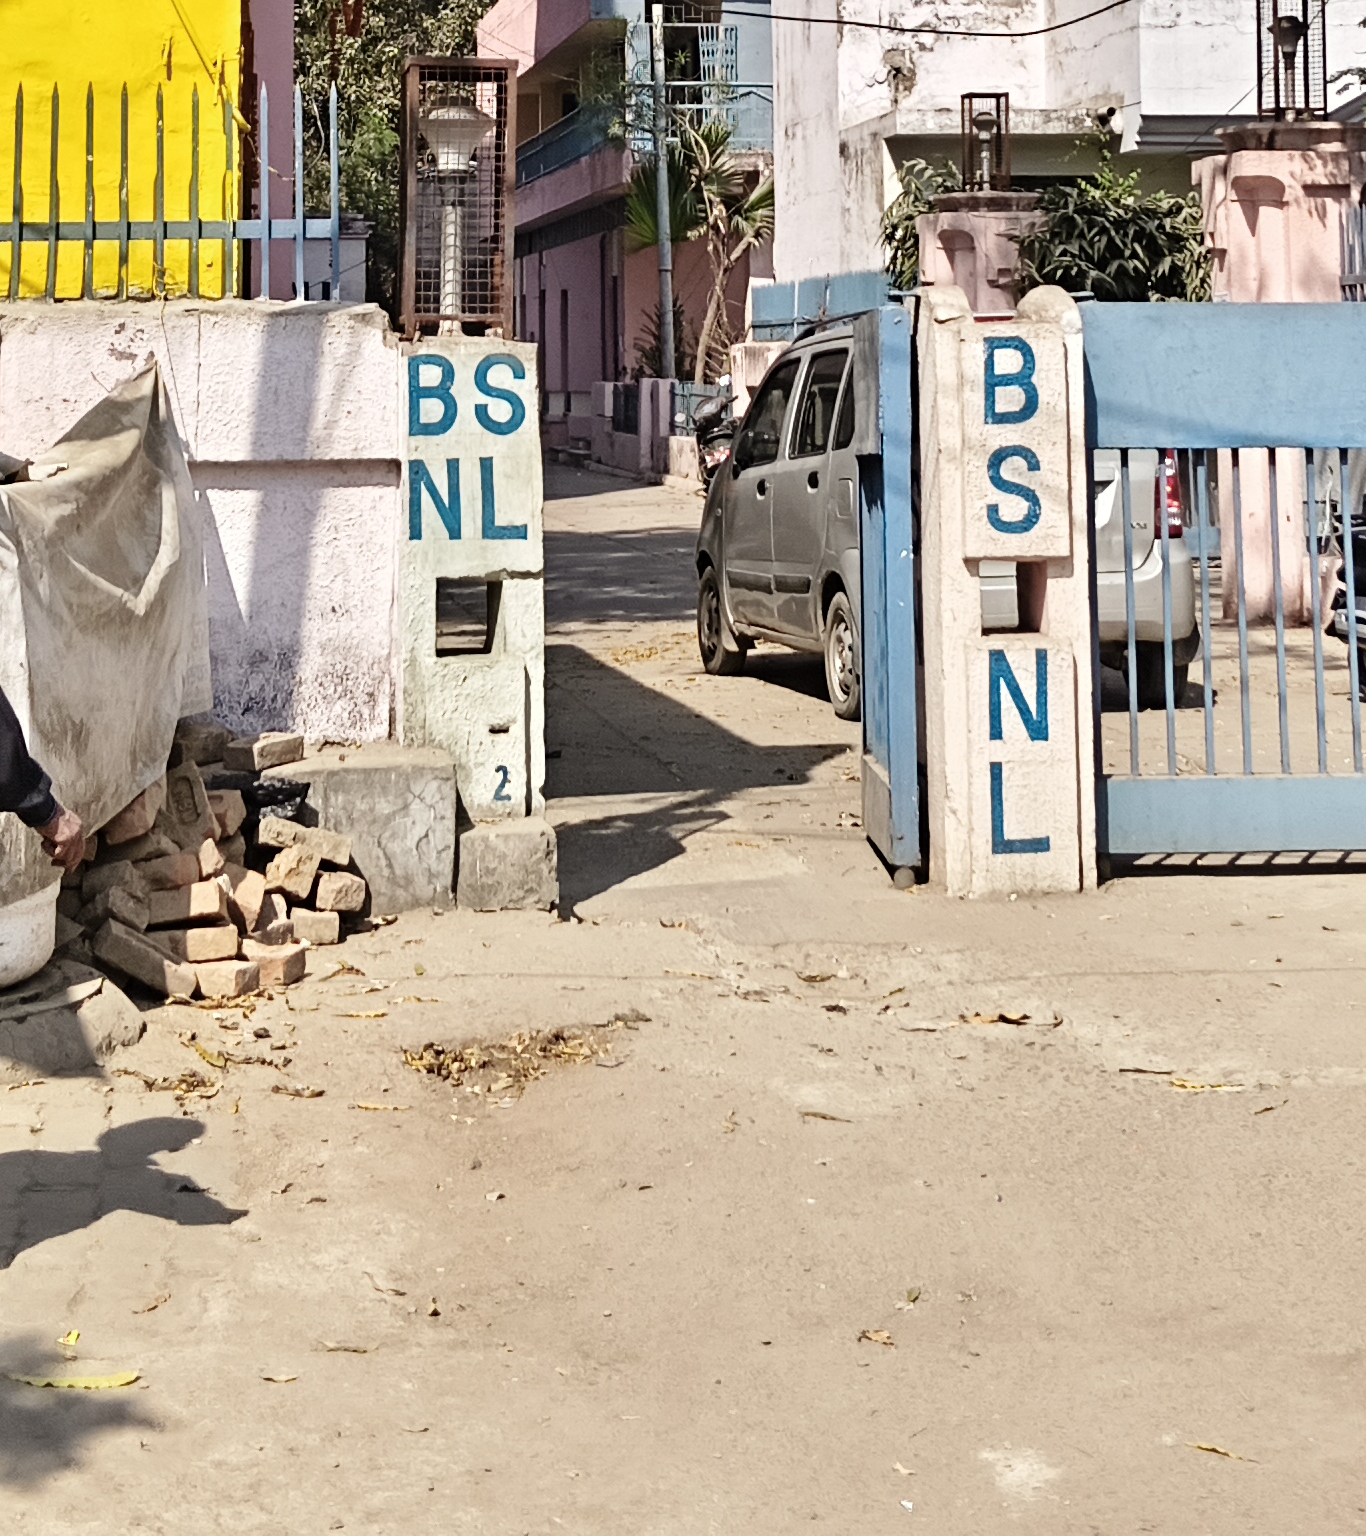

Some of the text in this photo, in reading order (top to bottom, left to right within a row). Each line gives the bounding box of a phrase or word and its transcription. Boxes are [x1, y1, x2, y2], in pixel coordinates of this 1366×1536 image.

[408, 354, 526, 436] BS
[408, 457, 528, 541] NL
[492, 764, 512, 802] 2
